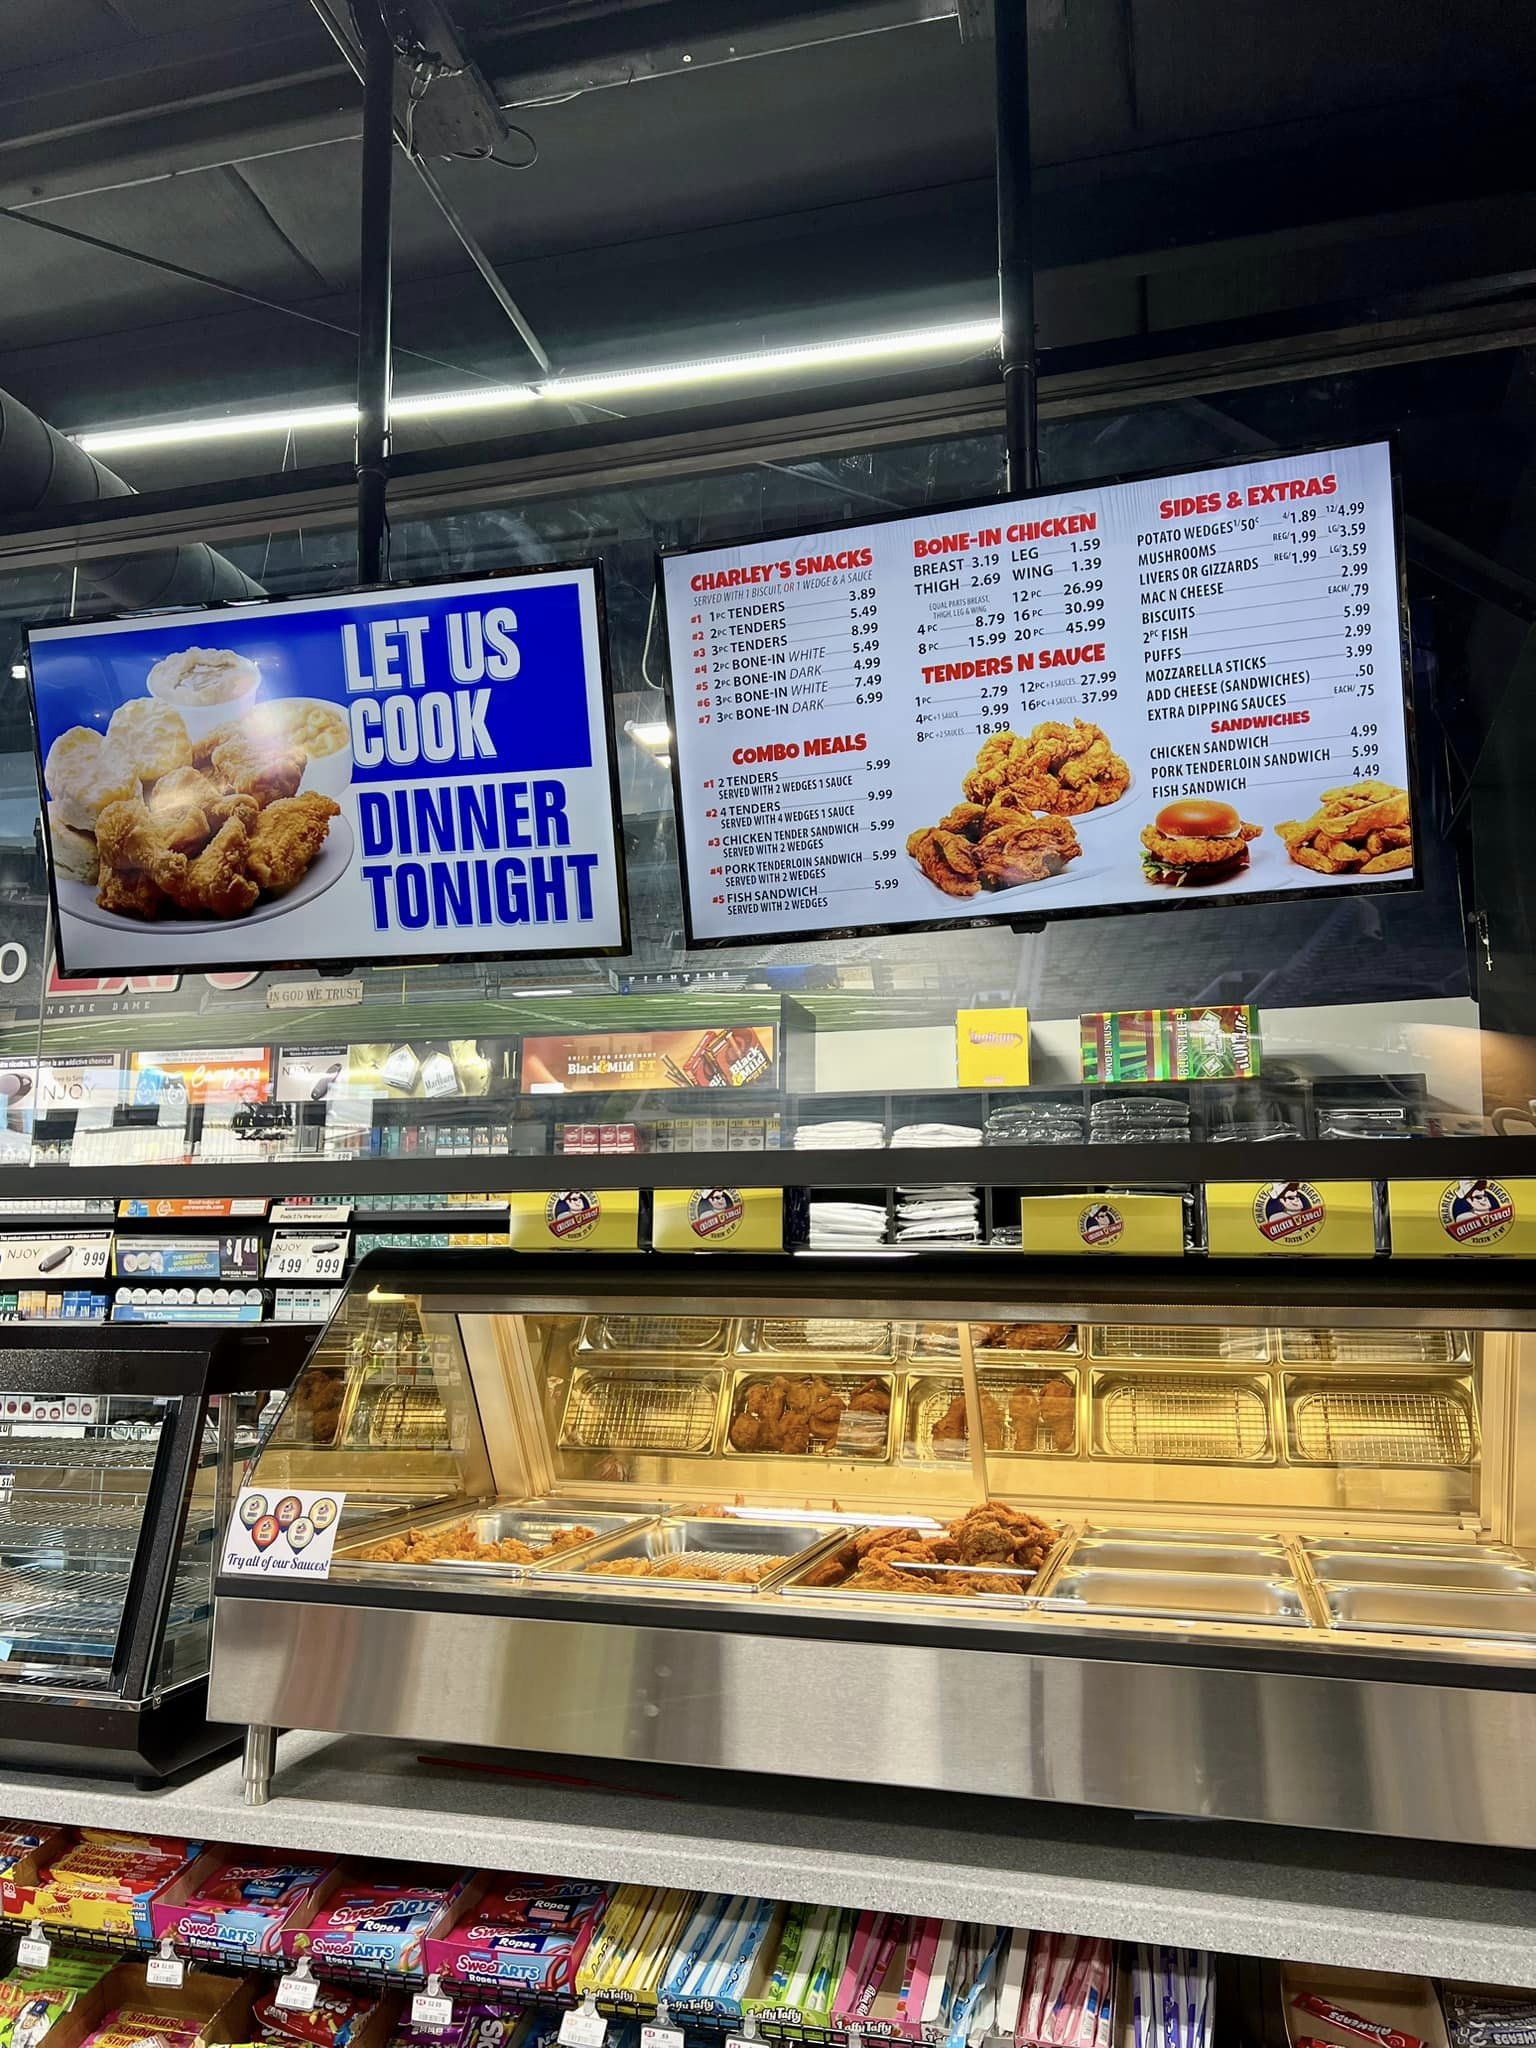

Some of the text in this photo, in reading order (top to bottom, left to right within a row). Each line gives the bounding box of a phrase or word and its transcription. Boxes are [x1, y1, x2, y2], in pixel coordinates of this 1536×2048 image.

[1159, 474, 1337, 520] SIDES & EXTRAS
[913, 512, 1097, 558] BONE-IN CHICKEN
[1137, 529, 1181, 546] POTATO
[1011, 538, 1101, 562] LEG 1.59
[1138, 544, 1217, 566] MUSHROOMS
[691, 548, 873, 592] CHARLEY'S SNACKS
[913, 554, 1000, 577] BREAST 3.19
[1012, 557, 1102, 581] WING 1.39
[1139, 568, 1179, 586] LIVERS
[1182, 565, 1198, 579] OR
[1201, 558, 1259, 576] GIZZARDS
[693, 592, 722, 607] SERVED
[724, 590, 744, 602] WITH
[751, 584, 781, 598] BISCUIT,
[783, 582, 795, 593] OR
[803, 576, 831, 590] WEDGE
[840, 574, 846, 583] A
[848, 570, 872, 583] SAUCE
[914, 572, 1001, 595] THIGH 2.69
[1012, 579, 1103, 604] 12 PC 26.99
[1141, 563, 1368, 605] MAC N CHEESE 2.99
[728, 601, 785, 619] TENDERS
[849, 588, 876, 602] 3.89
[692, 632, 704, 641] #2
[729, 618, 786, 636] TENDERS
[851, 605, 877, 618] 5.49
[341, 607, 521, 693] LET US
[1145, 623, 1371, 663] PUFFS 2.99
[694, 665, 707, 674] #4
[732, 653, 785, 670] BONE-IN
[788, 647, 826, 662] WHITE
[853, 640, 879, 653] 5.49
[922, 643, 1106, 684] TENDERS N SAUCE
[1145, 644, 1373, 682] MOZZARELLA STICKS 3.99
[981, 685, 1008, 699] 2.79
[981, 703, 1009, 717] 9.99
[1211, 710, 1310, 734] SANDWICHES
[349, 688, 498, 769] COOK
[732, 733, 867, 765] COMBO MEALS
[1150, 724, 1377, 760] CHICKEN SANDWICH 4.99
[718, 778, 725, 787] 2
[727, 772, 778, 787] TENDERS
[866, 759, 891, 771] 5.99
[719, 776, 853, 800] SERVED WITH 2 WEDGES 1 SAUCE
[356, 779, 572, 859] DINNER
[708, 820, 895, 847] #3 CHICKEN TENDER SANDWICH 5.99
[710, 850, 897, 875] #4 PORK TENDERLOIN SANDWICH 5.99
[361, 854, 599, 932] TONIGHT
[628, 971, 730, 984] FIGHTING
[269, 987, 361, 1000] IN GOD WE TRUST
[46, 1000, 151, 1015] NOTRE DAME
[1176, 1013, 1188, 1076] BLUNTLIFE
[1231, 1013, 1249, 1070] BLUNTLIFE
[43, 1084, 95, 1100] NJOY
[1301, 1184, 1321, 1204] BIGGS
[1489, 1183, 1509, 1203] BIGGS
[1255, 1190, 1270, 1223] CHARLEY
[1441, 1190, 1456, 1223] CHARLEY
[1270, 1219, 1294, 1235] CHICKEN
[1457, 1219, 1481, 1236] CHICKEN
[7, 1249, 40, 1259] NJOY
[275, 1243, 302, 1252] NJOY
[278, 1258, 302, 1273] 499
[315, 1258, 340, 1274] 999
[227, 1553, 329, 1571] Try all of our Sauces!
[534, 1900, 570, 1911] Ropes
[178, 1918, 256, 1945] SweeTARTS
[363, 1920, 401, 1933] Ropes
[312, 1938, 395, 1961] SweeTARTS
[498, 1937, 537, 1949] Ropes
[456, 1954, 541, 1980] SweeTARTS
[1329, 2011, 1392, 2036] AIRHEADS
